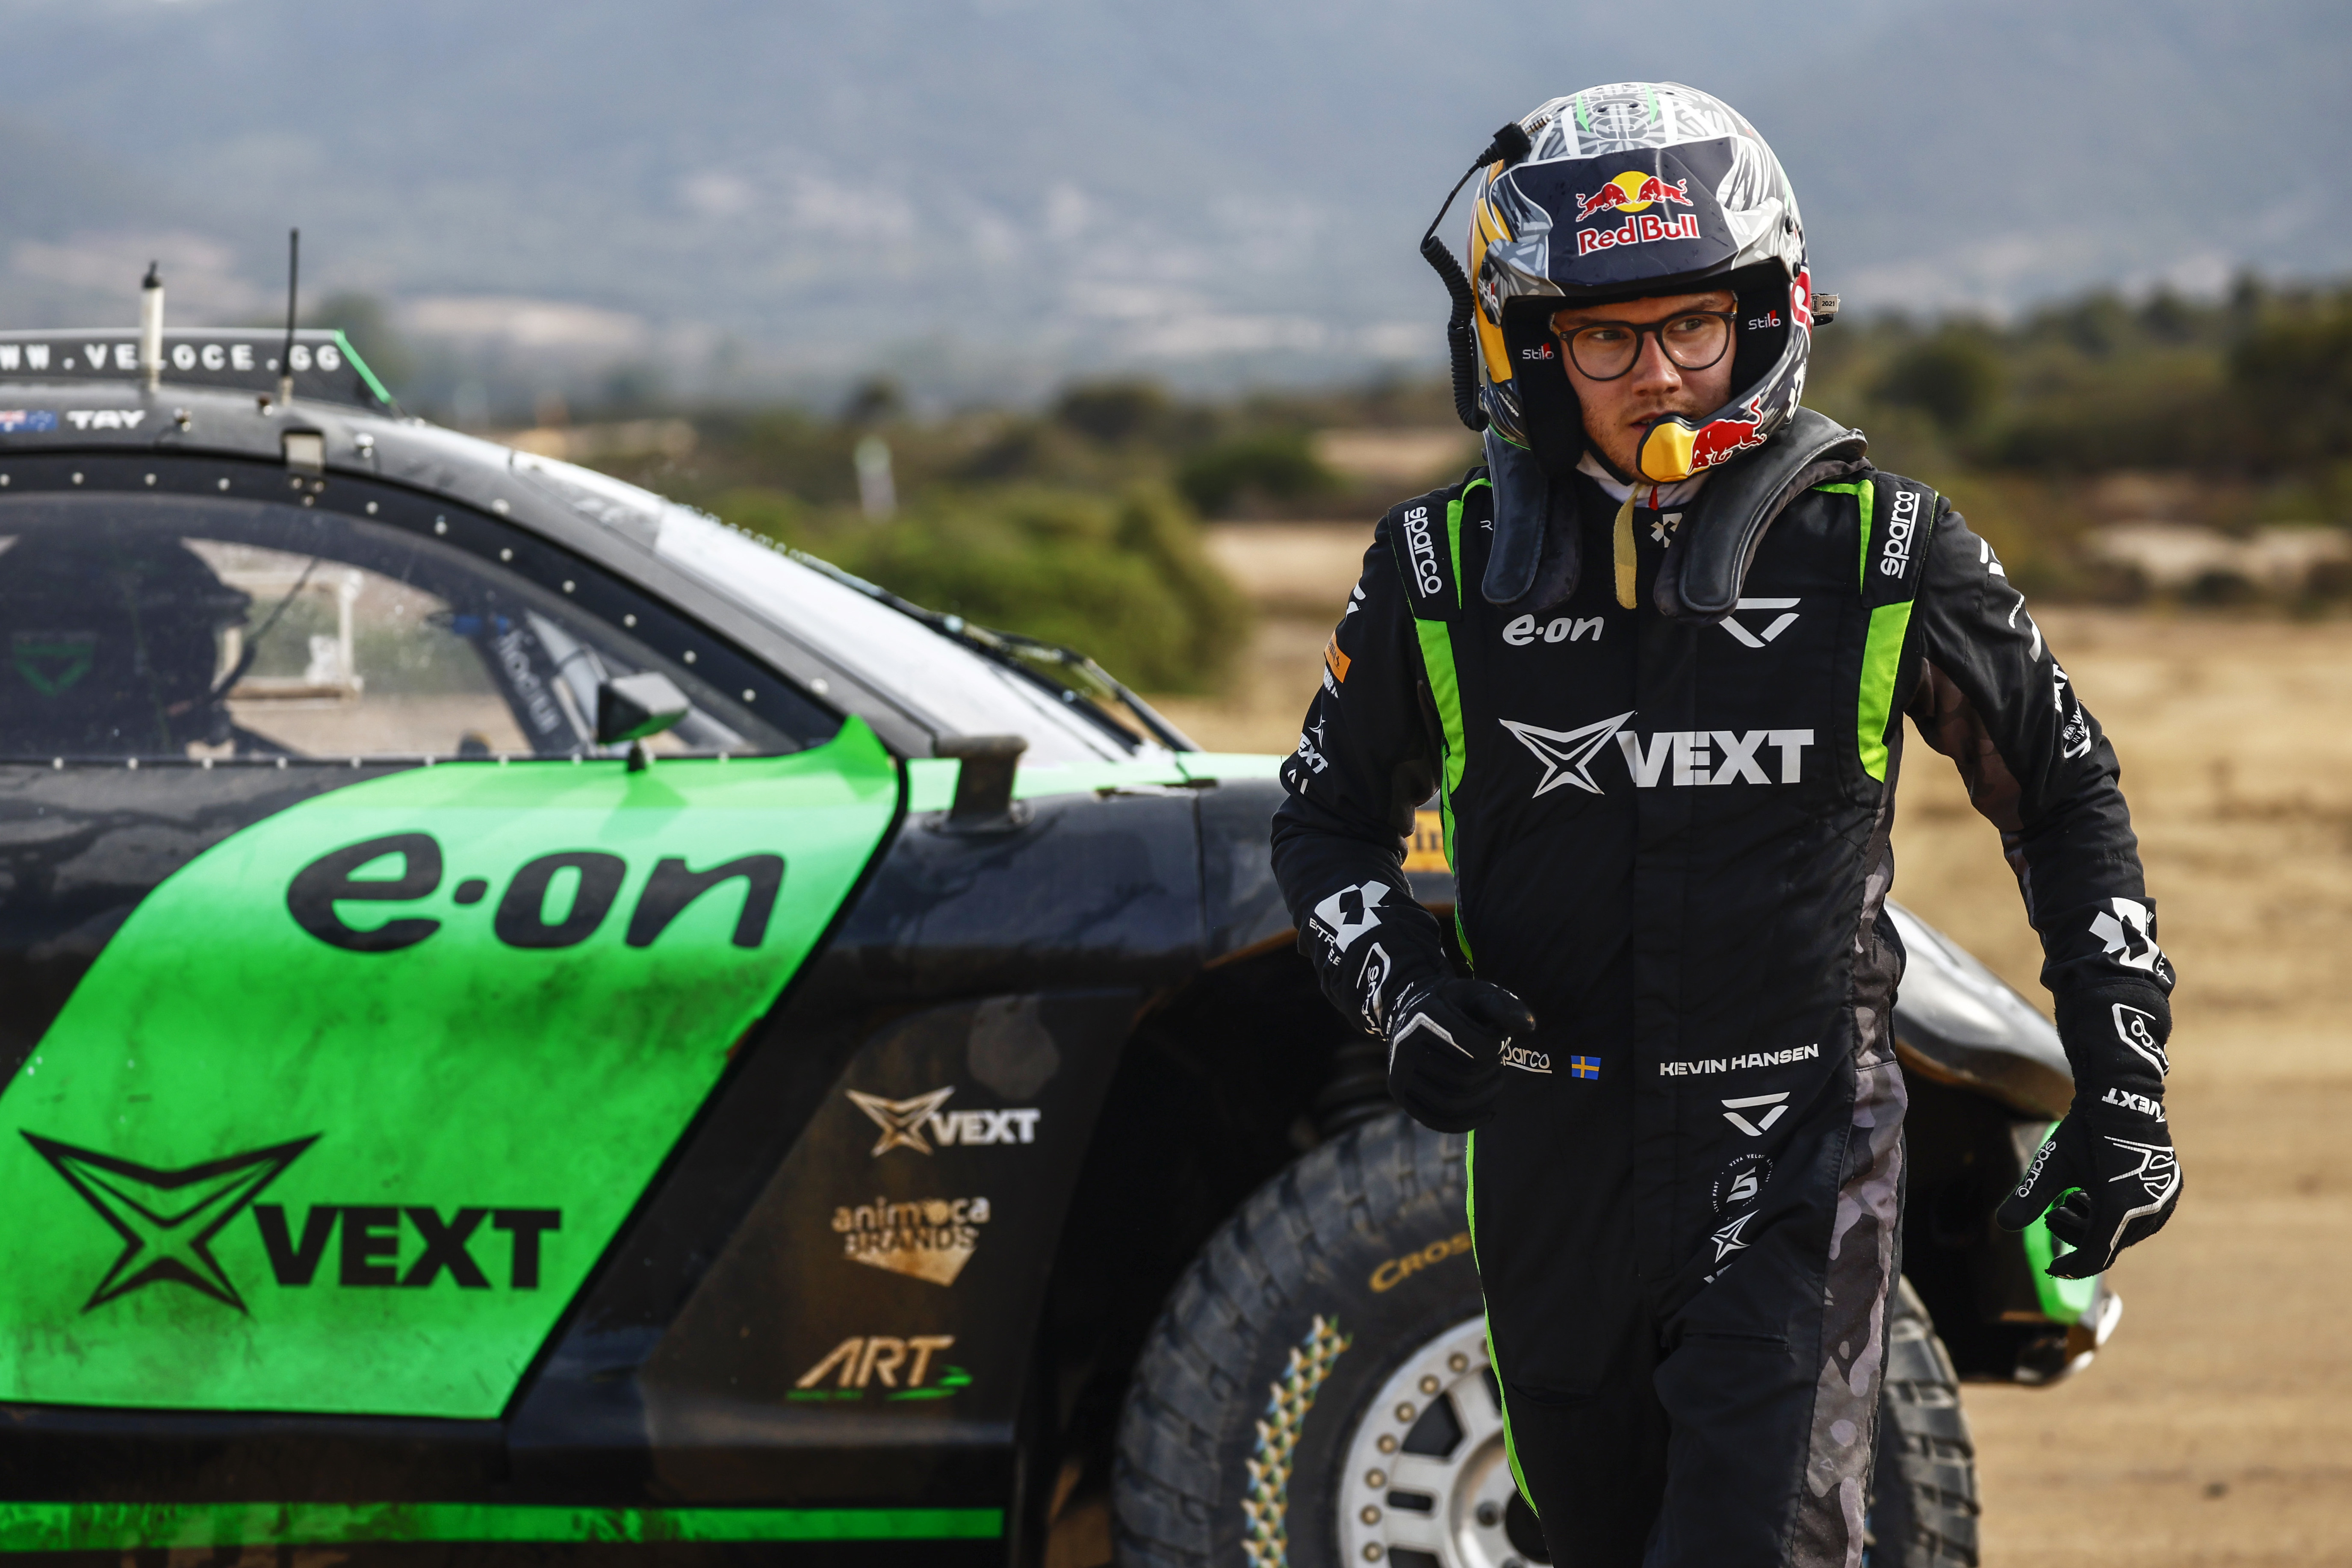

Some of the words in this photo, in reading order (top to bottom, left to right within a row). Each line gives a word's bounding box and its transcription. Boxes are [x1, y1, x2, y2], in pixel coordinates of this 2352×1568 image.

[1577, 215, 1639, 256] Red
[1638, 214, 1701, 242] Bull
[1749, 311, 1781, 330] Stilo
[1523, 344, 1554, 360] Stilo
[66, 410, 145, 430] TAY
[1404, 507, 1442, 598] sparco
[1880, 491, 1920, 579] sparco
[1615, 729, 1814, 787] VEXT
[1500, 1045, 1552, 1073] parco
[1660, 1059, 1726, 1076] KEVIN
[1732, 1043, 1819, 1070] HANSEN
[930, 1108, 1041, 1147] VEXT
[1729, 1157, 1743, 1166] VIVA
[2016, 1140, 2057, 1198] sparco
[253, 1205, 561, 1290] VEXT
[795, 1335, 956, 1388] ART
